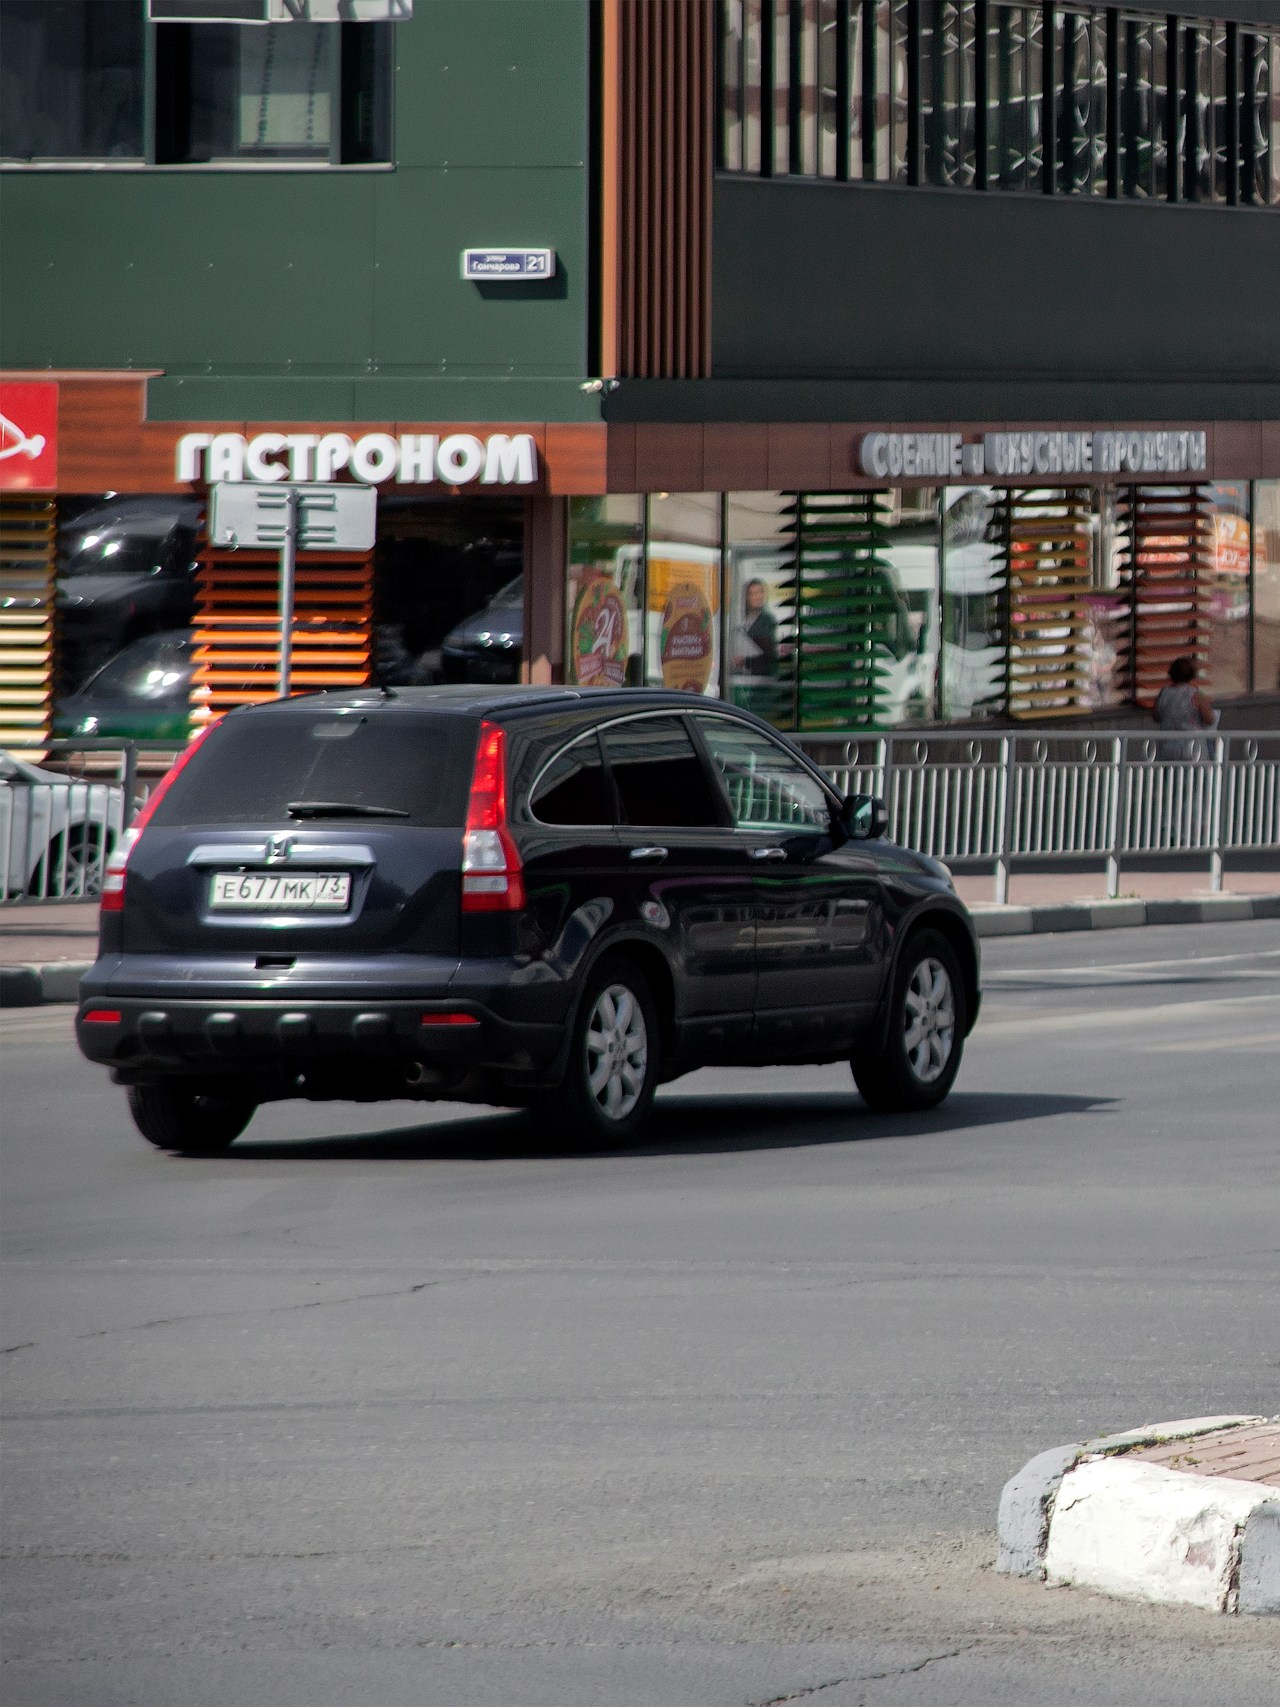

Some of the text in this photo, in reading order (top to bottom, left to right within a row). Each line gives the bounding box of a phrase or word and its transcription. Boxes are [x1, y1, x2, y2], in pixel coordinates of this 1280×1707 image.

[473, 261, 521, 272] Гончарова
[527, 256, 545, 271] 21
[175, 432, 539, 485] ГАСТРОНОМ
[861, 432, 962, 478] СВЕЖИЕ
[985, 432, 1093, 476] ВКУСНЫЕ
[1093, 431, 1206, 473] ПРОДУКТЫ
[320, 875, 341, 893] 73
